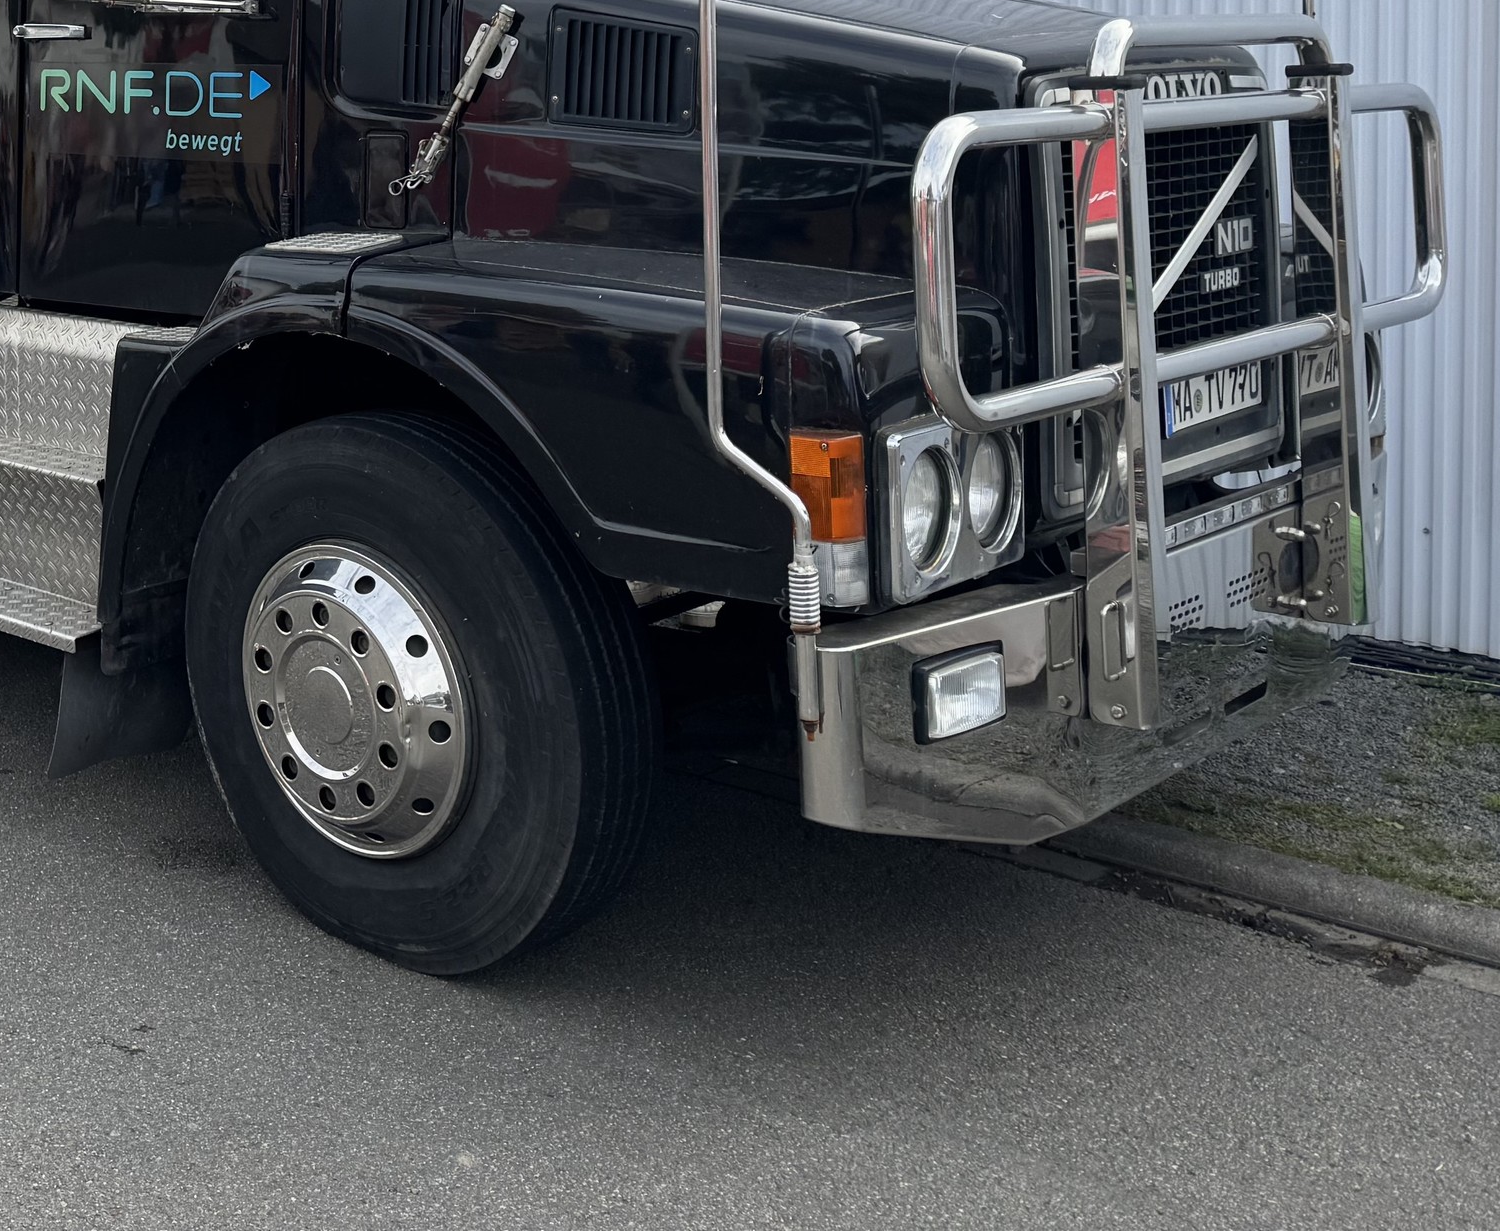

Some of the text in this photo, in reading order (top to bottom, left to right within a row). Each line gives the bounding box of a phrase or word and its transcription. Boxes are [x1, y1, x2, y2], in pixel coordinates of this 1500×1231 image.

[40, 69, 243, 119] RNF.DE
[1147, 71, 1222, 100] OLVO
[166, 129, 243, 155] bewegt
[1217, 218, 1253, 255] N10
[1204, 267, 1240, 292] TURBO
[1205, 370, 1225, 413] TV
